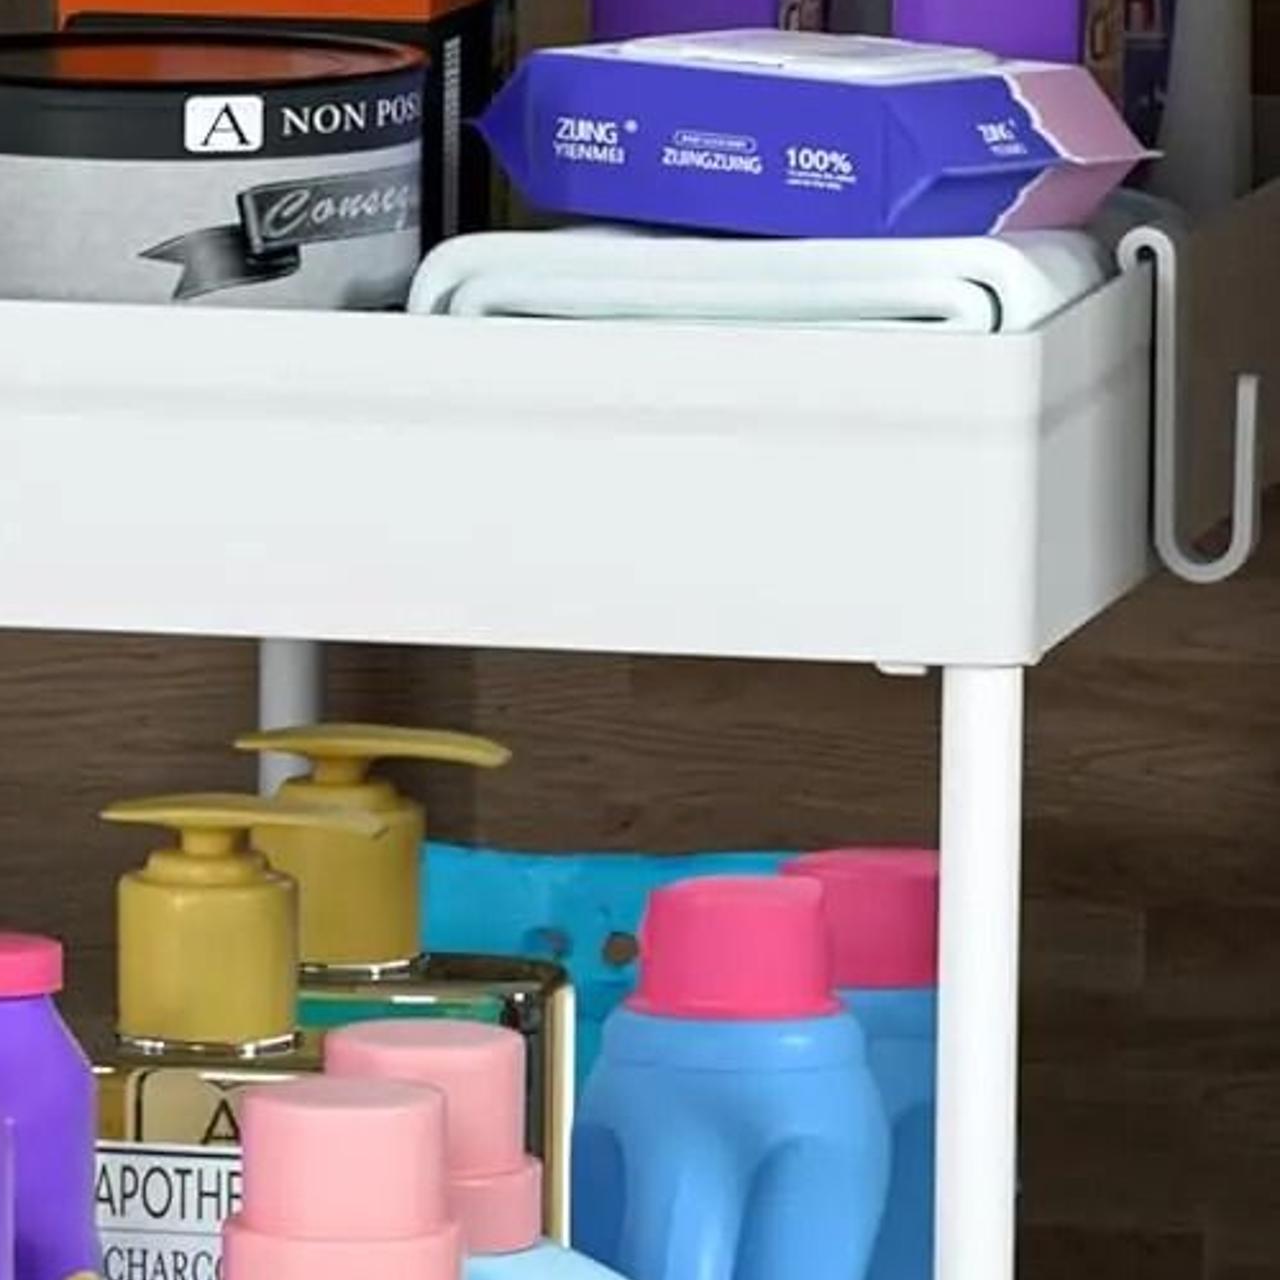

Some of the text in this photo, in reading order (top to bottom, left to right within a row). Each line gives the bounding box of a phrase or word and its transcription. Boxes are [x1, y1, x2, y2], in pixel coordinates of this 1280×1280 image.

[202, 103, 250, 146] A
[281, 100, 367, 137] NON
[786, 147, 853, 174] 100%
